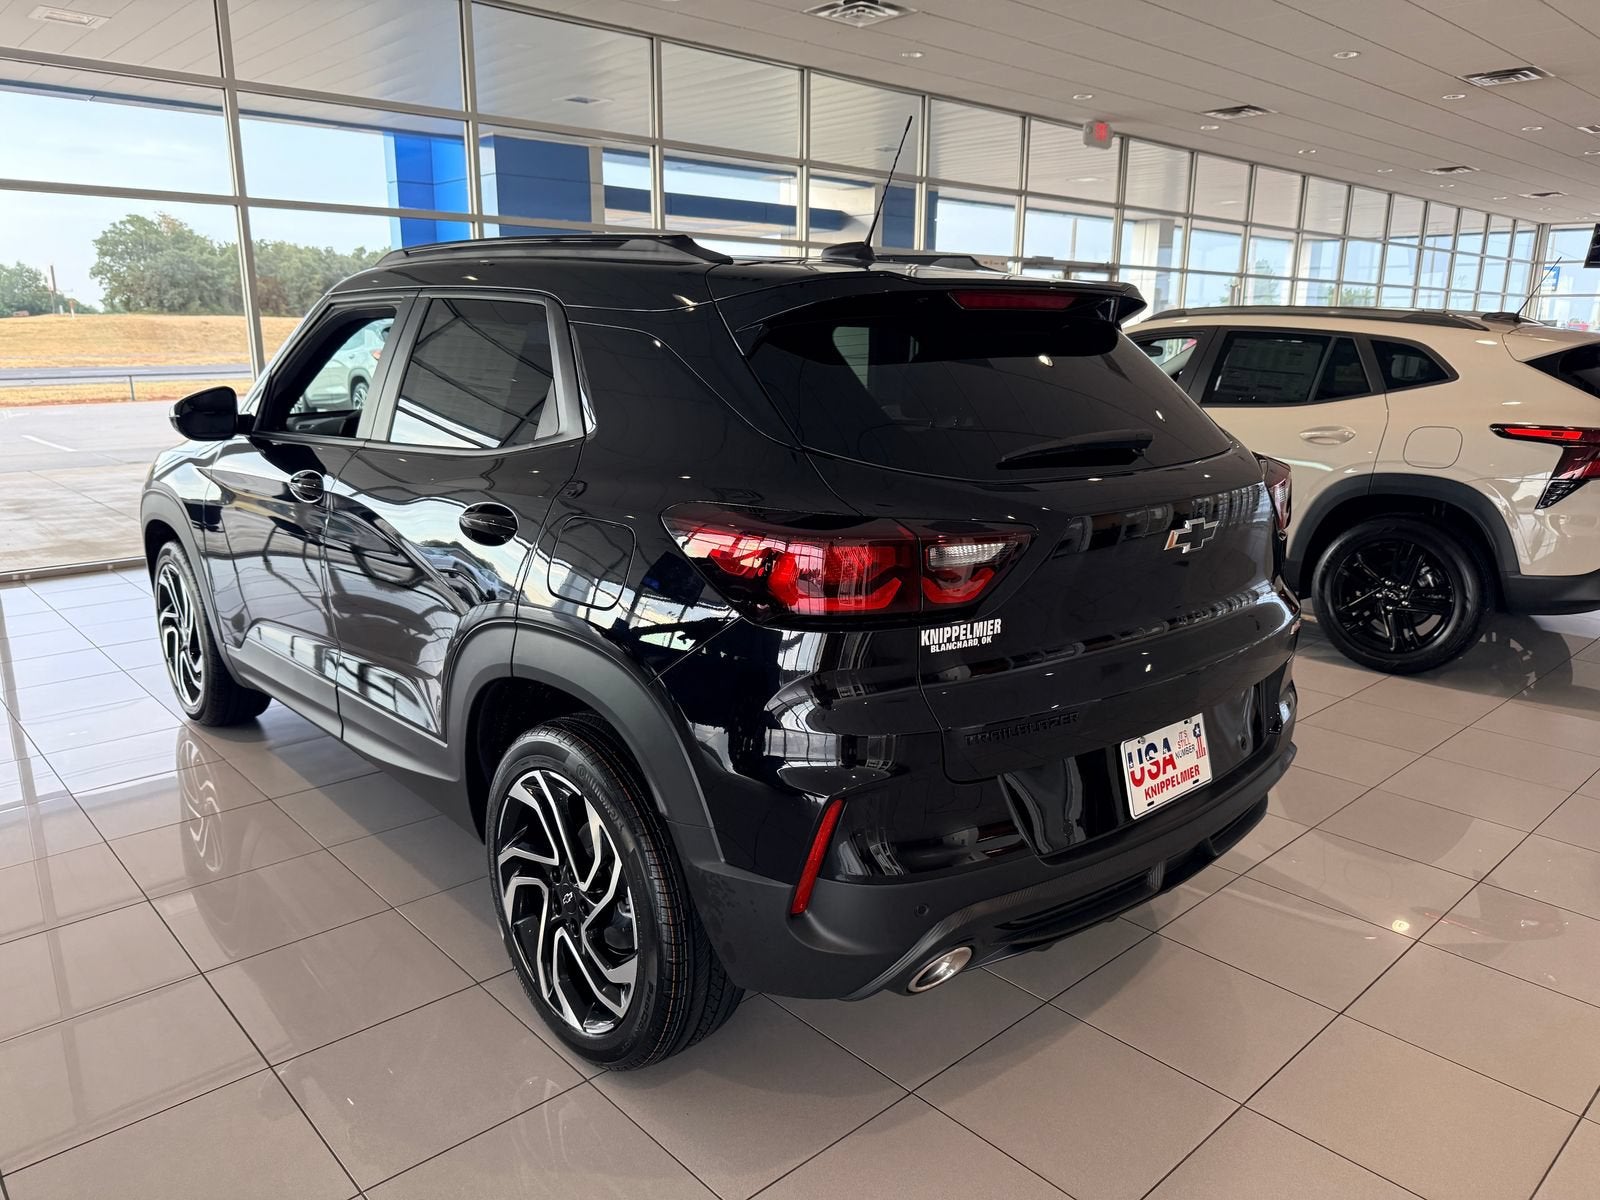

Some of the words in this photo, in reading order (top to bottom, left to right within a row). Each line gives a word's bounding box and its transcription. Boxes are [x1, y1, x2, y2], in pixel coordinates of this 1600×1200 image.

[921, 619, 1001, 646] KNIPPELMIER
[931, 638, 980, 653] BLANCHARD,
[982, 636, 992, 645] OK
[964, 712, 1080, 745] TRAILBLAZER
[1175, 744, 1195, 759] NUMBER
[1177, 738, 1191, 749] STILL
[1127, 737, 1177, 787] USA
[1144, 765, 1200, 800] KNIPPELMIER
